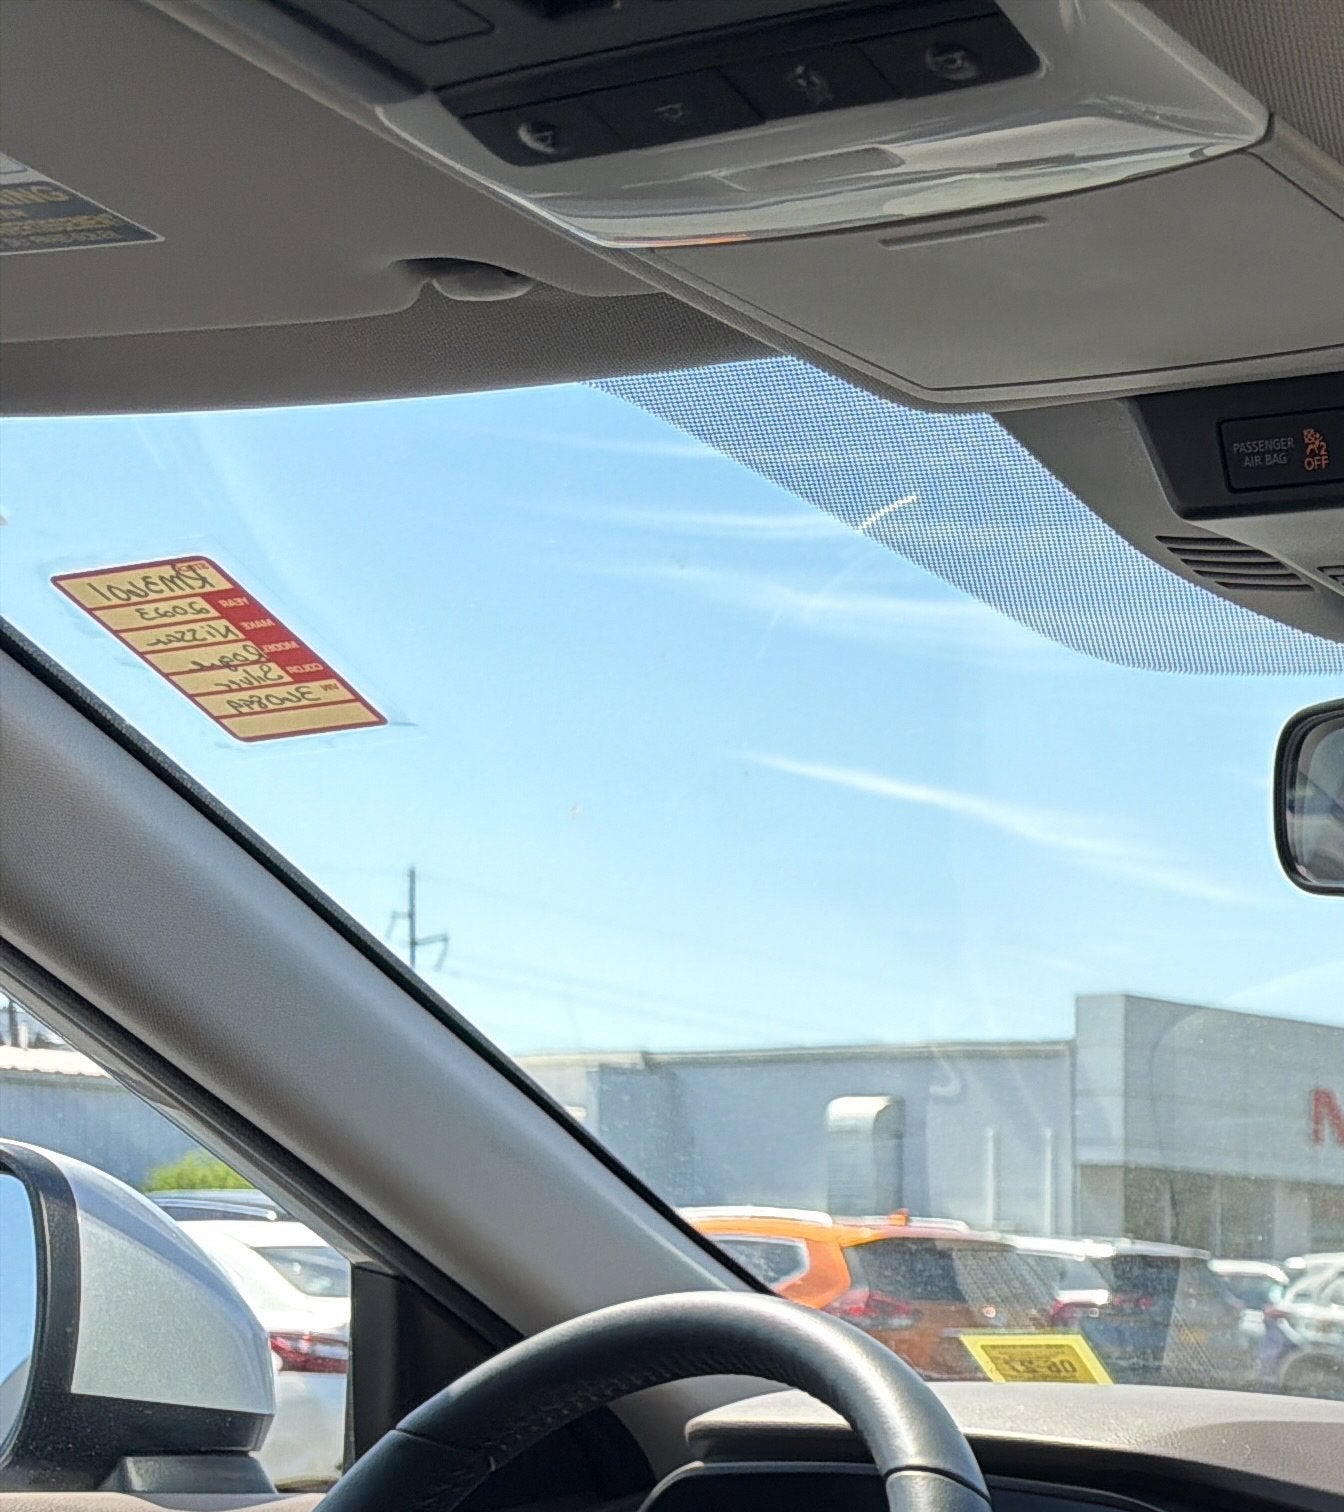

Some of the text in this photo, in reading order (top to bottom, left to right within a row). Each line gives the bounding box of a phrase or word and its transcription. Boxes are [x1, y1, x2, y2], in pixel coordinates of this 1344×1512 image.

[1233, 437, 1295, 454] PASSENGER
[1243, 452, 1288, 468] AIR BAG
[1304, 455, 1329, 471] OFF
